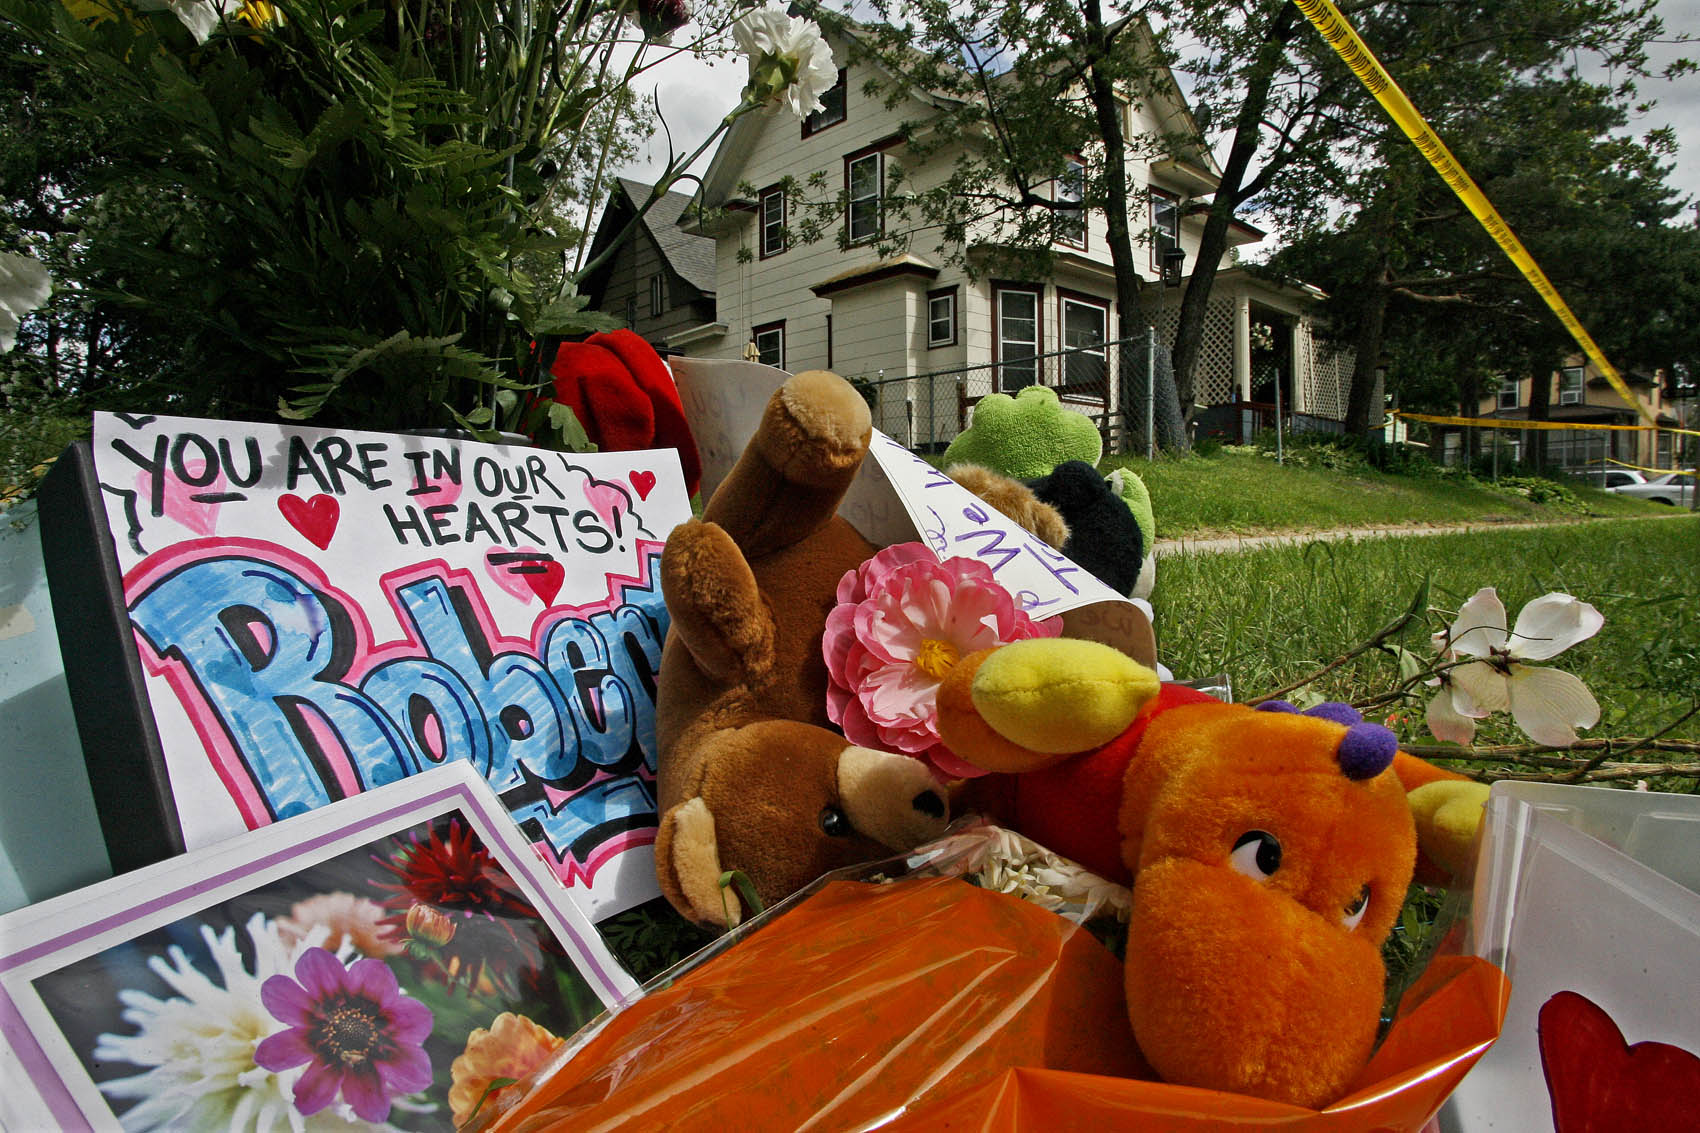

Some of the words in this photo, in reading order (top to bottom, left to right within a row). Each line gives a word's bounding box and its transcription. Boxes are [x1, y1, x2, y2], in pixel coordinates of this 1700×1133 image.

[111, 433, 263, 517] YOU
[287, 435, 392, 495] ARE
[403, 446, 462, 496] IN
[473, 455, 566, 500] OUR
[383, 501, 626, 554] HEARTS!
